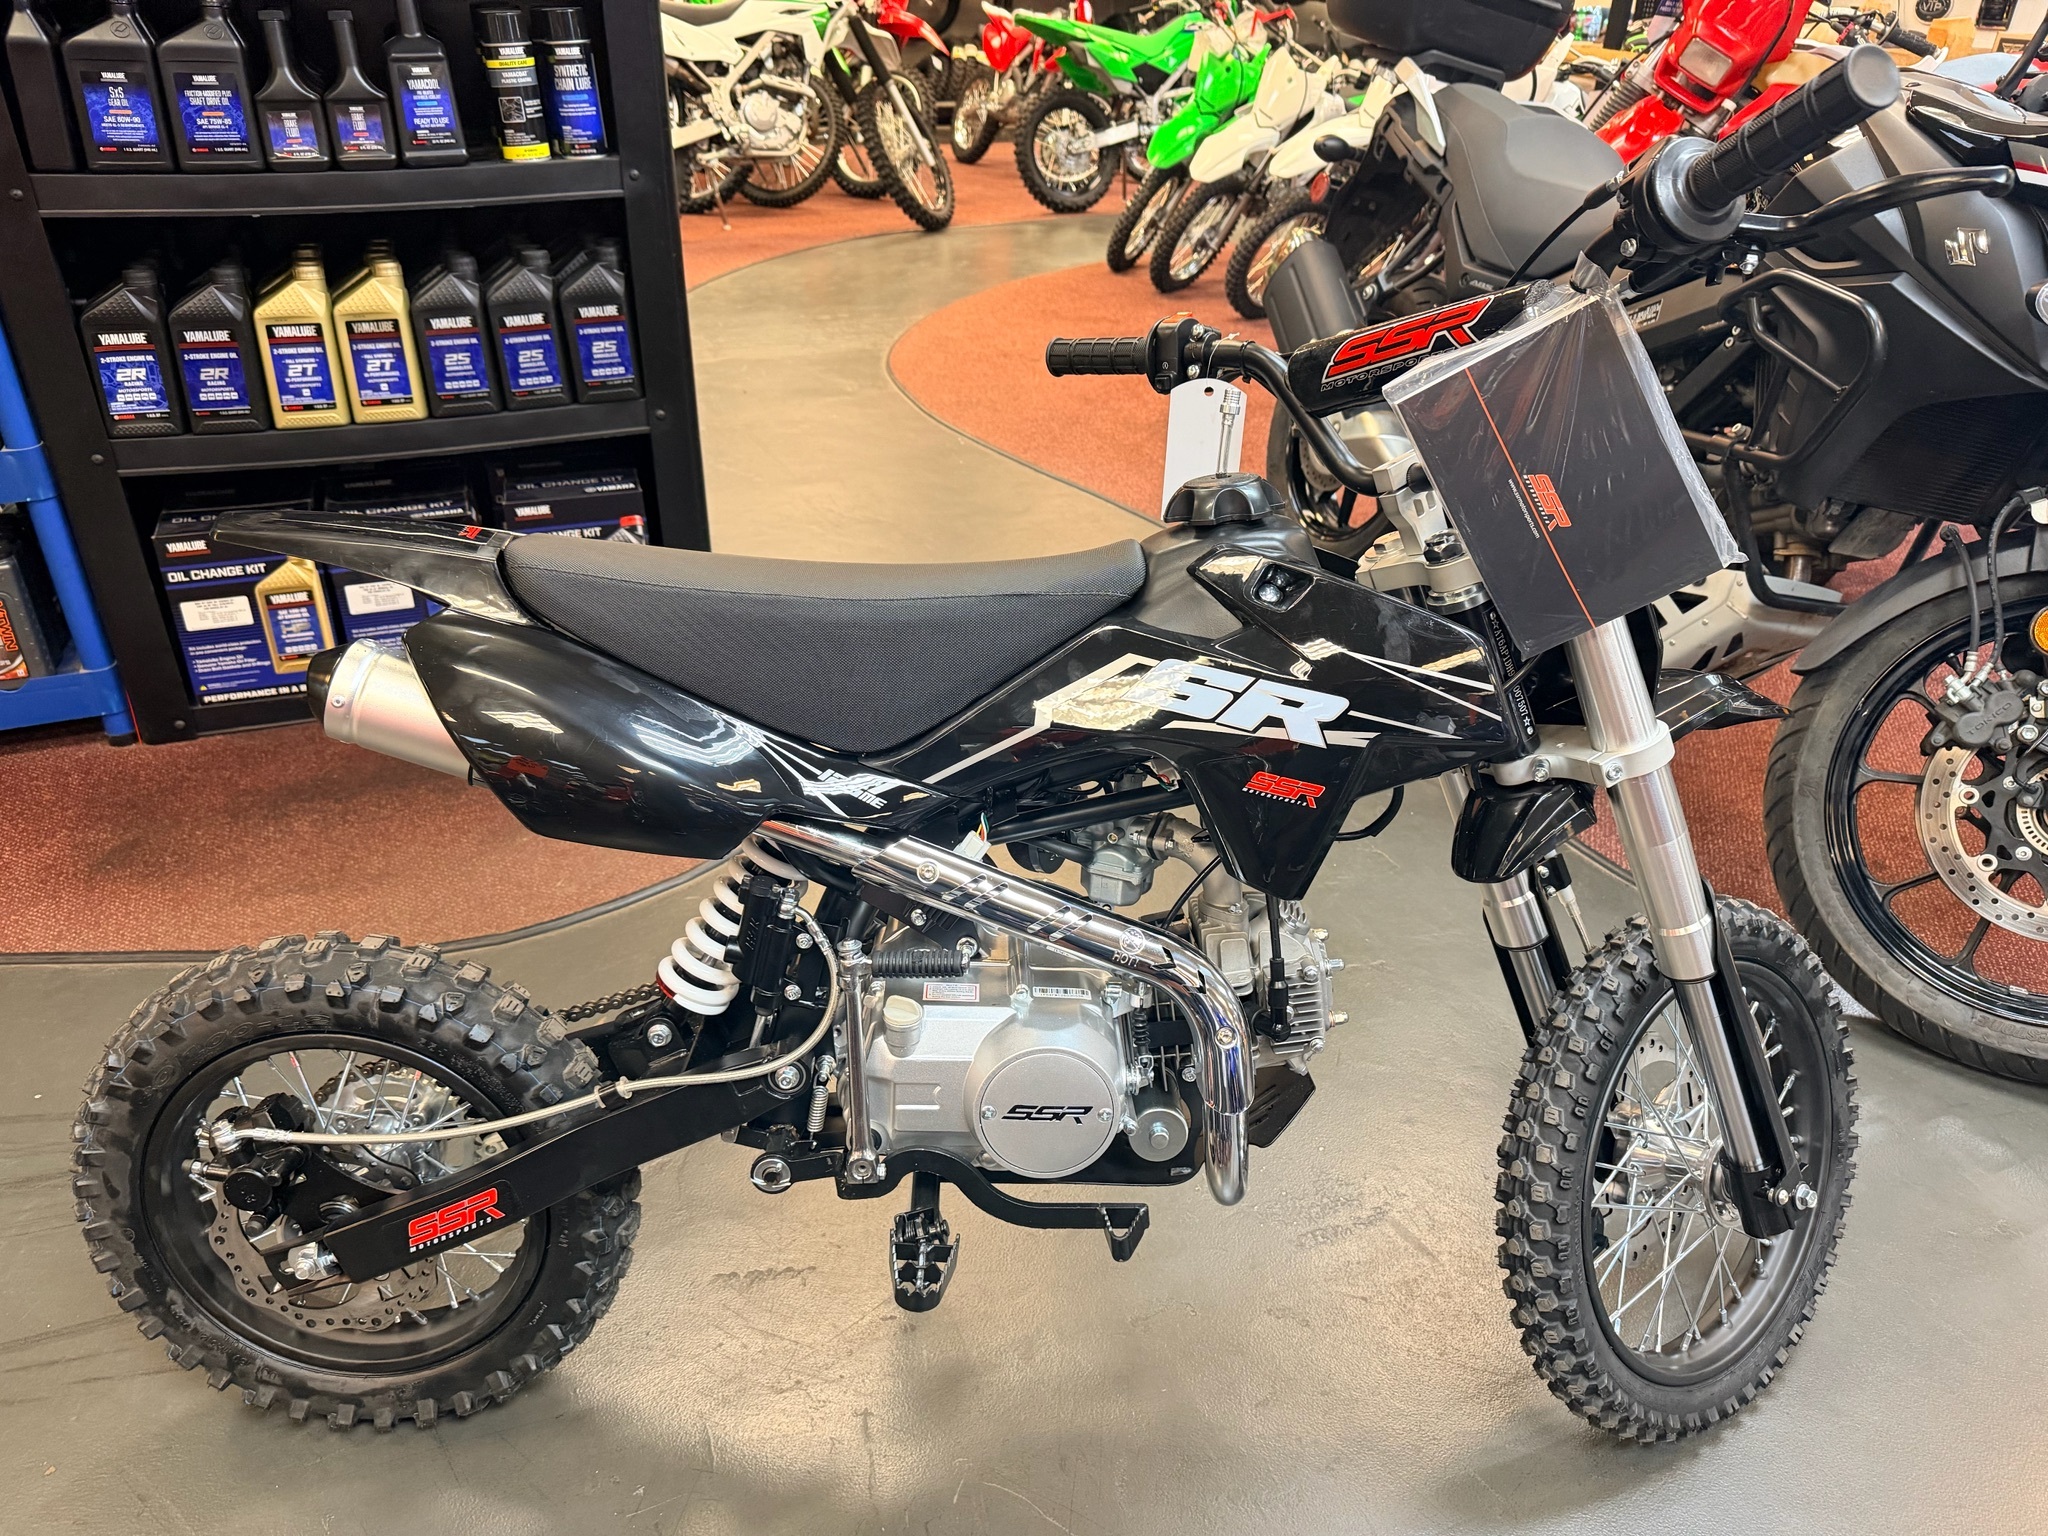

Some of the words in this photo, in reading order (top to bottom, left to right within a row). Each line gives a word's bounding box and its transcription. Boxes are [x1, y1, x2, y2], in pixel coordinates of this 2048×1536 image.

[499, 47, 525, 55] YAMALUBE
[555, 47, 581, 55] YAMALUBE
[554, 64, 588, 77] SYNTHETIC
[407, 79, 441, 90] YAMACOOL
[554, 78, 575, 91] CHAIN
[576, 77, 592, 90] LUBE
[189, 97, 205, 106] SHAFT
[206, 97, 221, 106] DRIVE
[222, 97, 230, 106] OIL
[352, 121, 367, 130] FLUID
[285, 128, 300, 137] FLUID
[578, 305, 619, 318] YAMALUBE
[351, 321, 396, 333] YAMALUBE
[429, 316, 473, 330] YAMALUBE
[503, 313, 545, 328] YAMALUBE
[183, 330, 231, 342] YAMALUBE
[272, 325, 318, 338] YAMALUBE
[1324, 296, 1493, 380] SSR
[98, 332, 148, 345] YAMALUBE
[100, 355, 126, 363] 2-STROKE
[366, 359, 396, 372] 2T
[116, 368, 147, 381] 2R
[200, 367, 229, 380] 2R
[288, 364, 318, 377] 2T
[541, 477, 599, 487] CHANGE
[597, 483, 636, 492] YAMAHA
[1523, 474, 1550, 524] MOTORSPORTS
[1528, 474, 1572, 531] SSR
[366, 503, 427, 515] CHANGE
[430, 500, 453, 509] KIT
[424, 508, 464, 517] YAMAHA
[514, 504, 551, 517] YAMALUBE
[584, 527, 602, 538] KIT
[166, 540, 208, 553] YAMALUBE
[168, 571, 190, 583] OIL
[190, 565, 245, 581] CHANGE
[246, 563, 267, 575] KIT
[270, 591, 309, 605] YAMALUBE
[203, 687, 278, 703] PERFORMANCE
[278, 685, 290, 694] IN
[1245, 771, 1325, 808] SSR
[1242, 787, 1307, 806] MOTORSPORTS
[1112, 950, 1140, 967] HOT!
[1001, 1105, 1093, 1125] SSR
[408, 1188, 506, 1247] SSR
[410, 1217, 492, 1253] MOTORSPORTS
